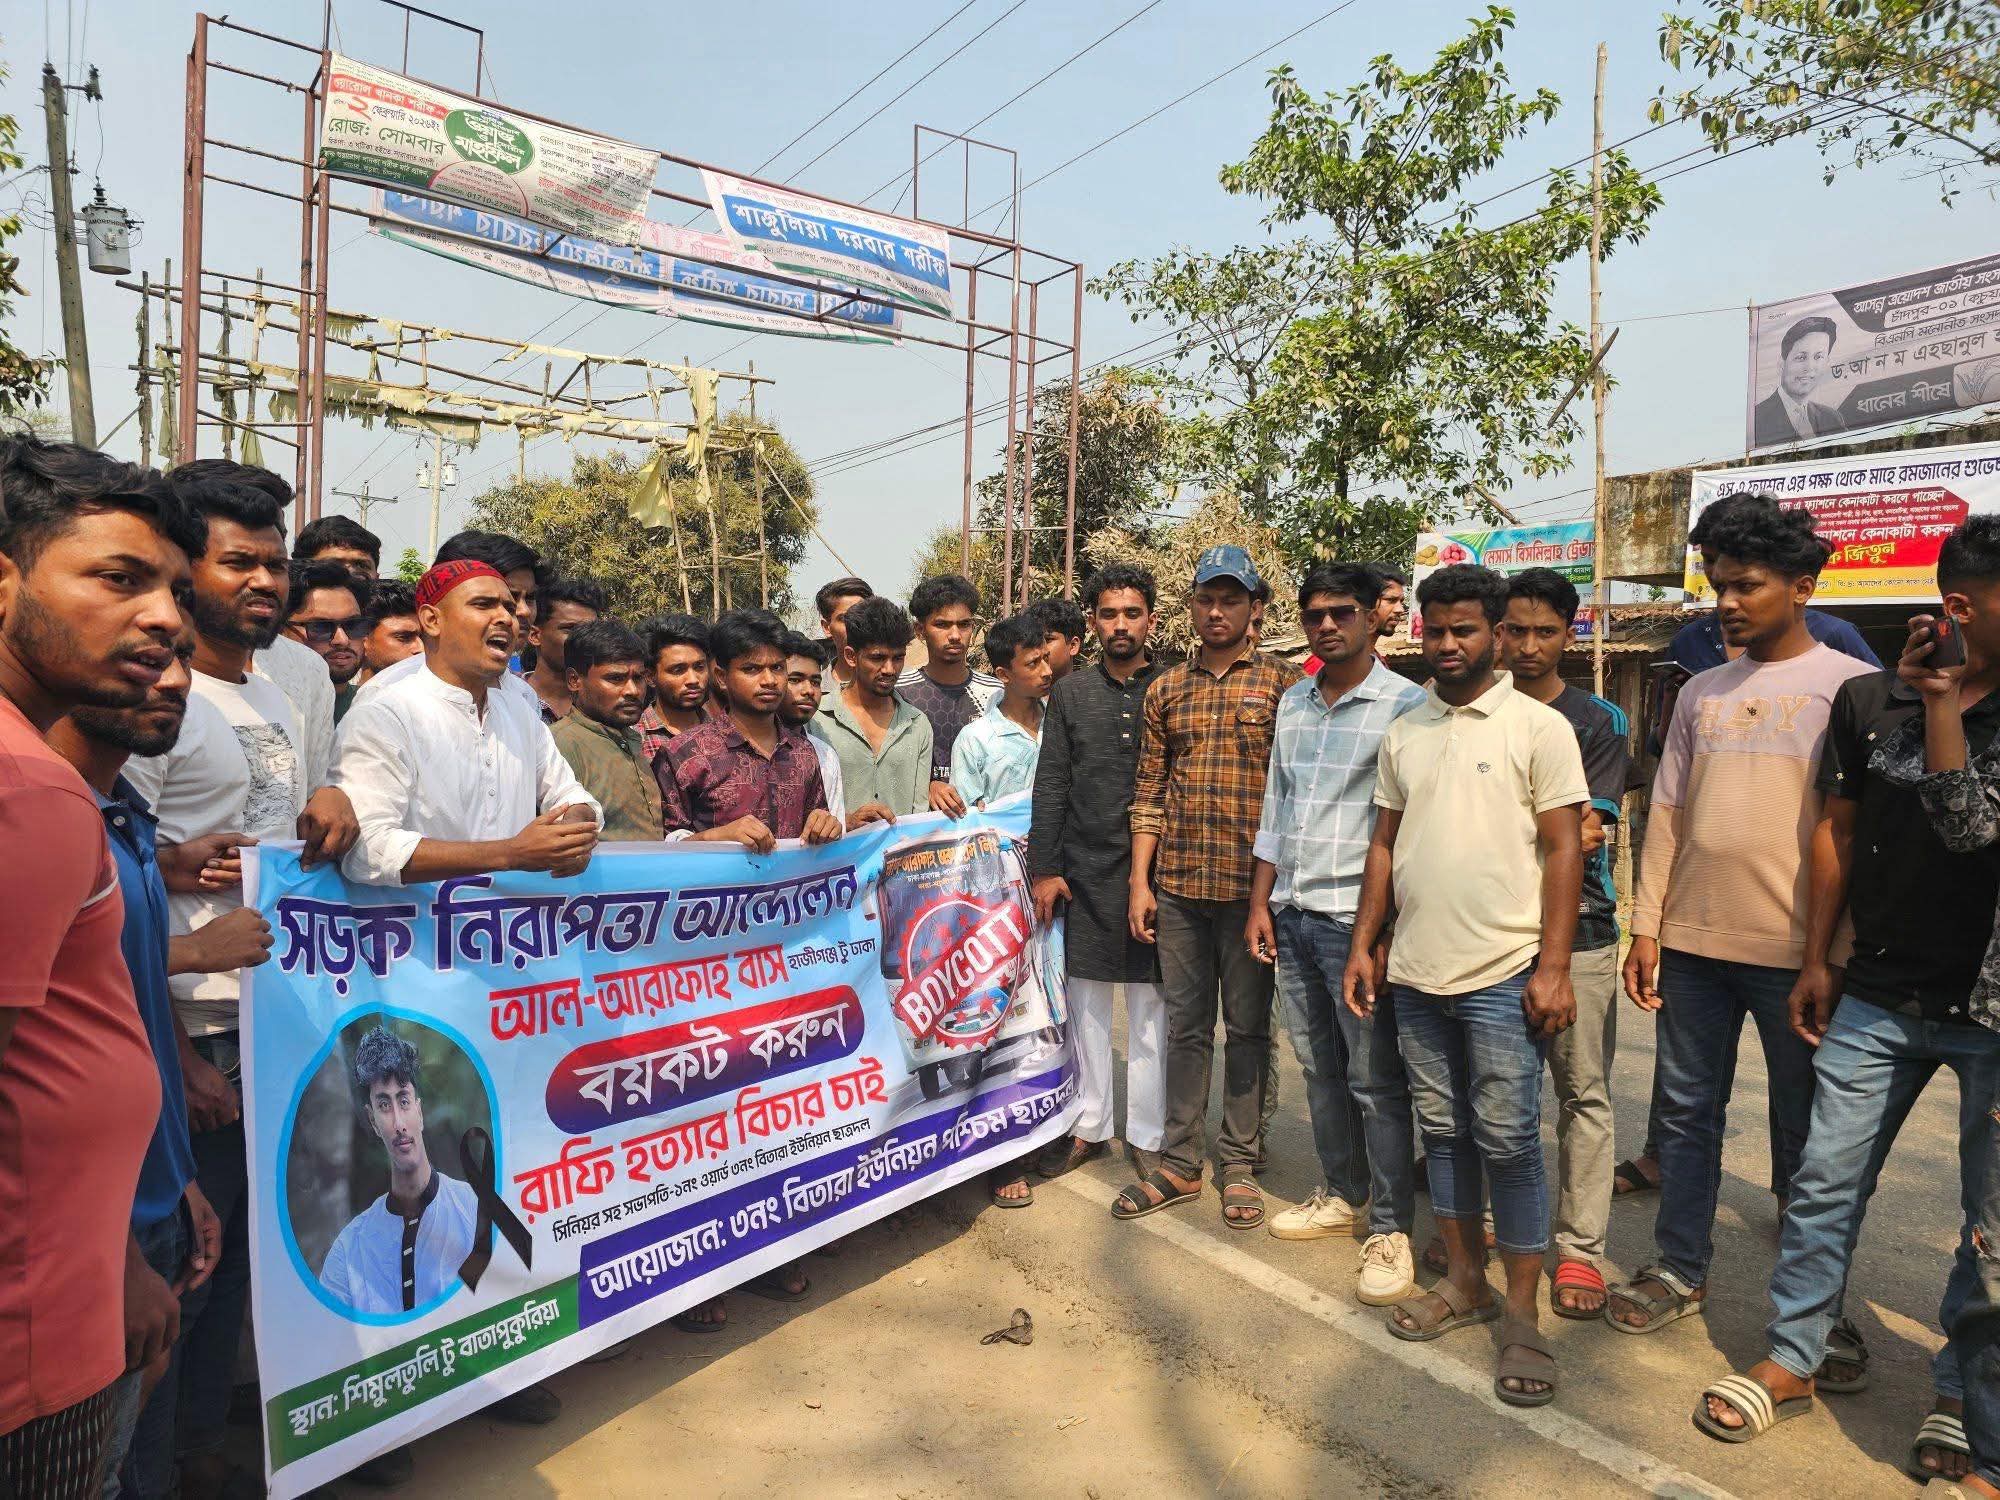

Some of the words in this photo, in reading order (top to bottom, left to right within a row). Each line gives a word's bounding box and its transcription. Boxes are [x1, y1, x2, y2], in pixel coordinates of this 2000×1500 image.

[348, 96, 372, 121] ২
[378, 127, 446, 156] সোমবার
[731, 202, 828, 242] শাজুলিয়া
[831, 226, 896, 262] দরবার
[900, 245, 946, 278] শরীফ
[1853, 295, 1887, 314] আসন্ন
[1933, 273, 1974, 295] জাতীয়
[1873, 353, 1890, 371] ন
[1894, 349, 1909, 366] ম
[1913, 331, 1989, 361] এহছানুল
[1874, 326, 1916, 348] বিএনপি
[1918, 316, 1967, 338] মনোনীত
[1856, 389, 1907, 414] ধানের
[1910, 380, 1952, 403] শীষে
[1716, 481, 1736, 498] এস
[1787, 475, 1807, 493] এর
[1808, 472, 1834, 489] পক্ষ
[1835, 469, 1868, 487] থেকে
[1868, 466, 1897, 485] মাহে
[1898, 460, 1962, 485] রমজানের
[1838, 492, 1881, 508] কেনাকাটা
[1859, 522, 1918, 541] কেনাকাটা
[1920, 522, 1956, 538] করুন
[1844, 541, 1896, 564] জিতুন
[276, 895, 419, 998] সড়ক
[430, 872, 671, 972] নিরাপত্তা
[672, 864, 859, 943] আন্দোলন
[488, 952, 732, 1041] আল-আরাফাহ
[733, 942, 790, 991] বাস
[788, 945, 839, 971] হাজীগঞ্জ
[838, 940, 850, 964] টু
[849, 937, 877, 957] ঢাকা
[900, 905, 1024, 1034] BOYCOTT
[572, 1023, 734, 1116] বয়কট
[738, 1001, 850, 1069] করুন
[513, 1135, 615, 1225] রাফি
[620, 1110, 730, 1184] হত্যার
[734, 1080, 826, 1146] বিচার
[828, 1056, 890, 1112] চাই
[552, 1210, 601, 1244] সিনিয়র
[602, 1205, 622, 1225] সহ
[623, 1178, 699, 1215] সভাপতি-১নং
[699, 1157, 730, 1191] ওয়ার্ড
[731, 1156, 754, 1177] ৩নং
[754, 1144, 789, 1169] বিতারা
[789, 1128, 832, 1157] ইউনিয়ন
[832, 1117, 872, 1145] ছাত্রদল
[586, 1218, 728, 1299] আয়োজনে:
[729, 1195, 784, 1237] ৩নং
[782, 1163, 853, 1220] বিতারা
[855, 1134, 938, 1189] ইউনিয়ন
[941, 1109, 1008, 1152] পশ্চিম
[1008, 1073, 1075, 1126] ছাত্রদল
[287, 1393, 339, 1437] স্থান:
[343, 1344, 440, 1411] শিমুলতুলি
[440, 1338, 456, 1377] টু
[457, 1296, 561, 1359] বাতাপুকুরিয়া
